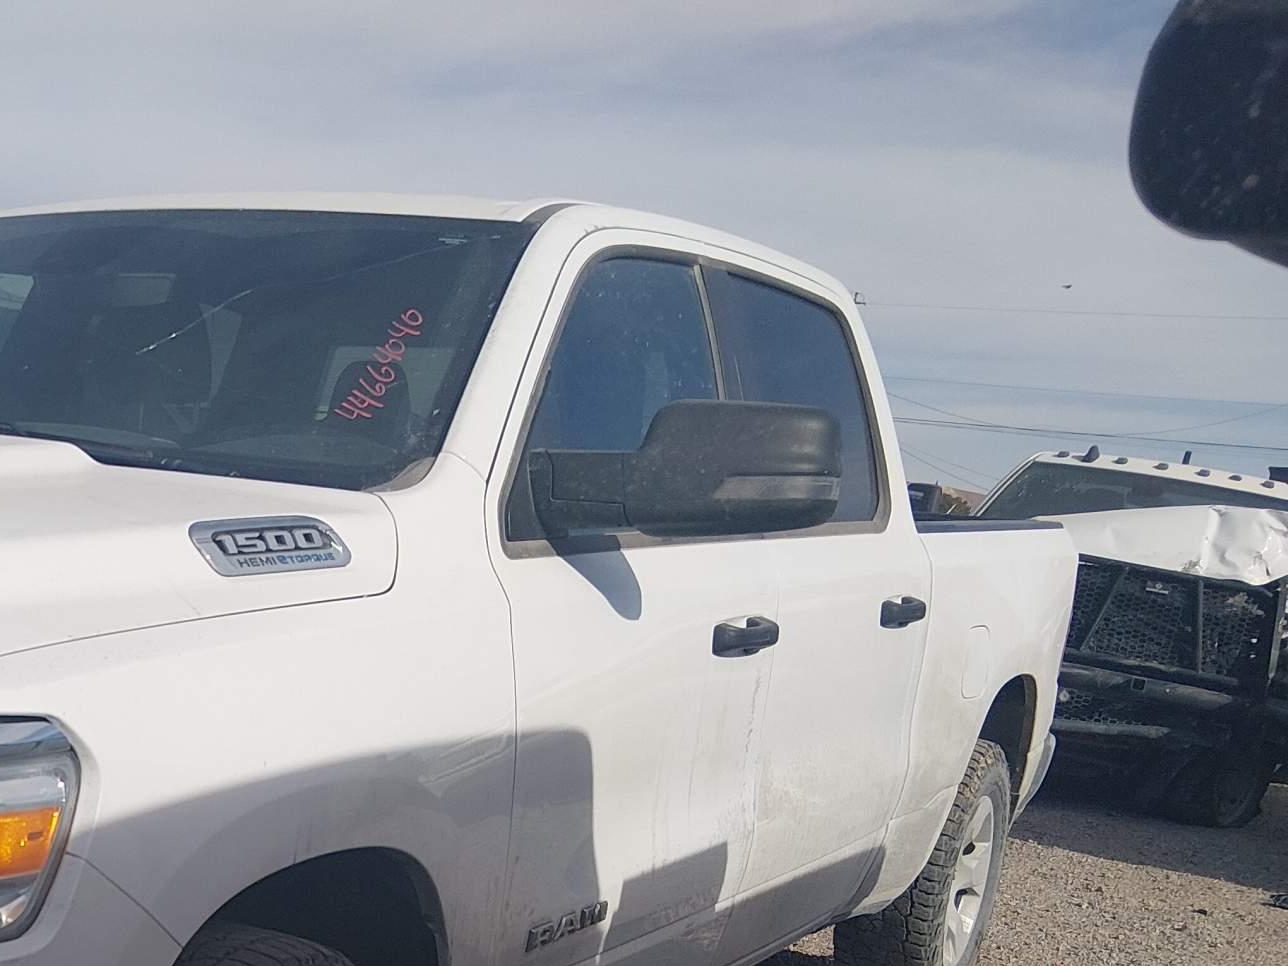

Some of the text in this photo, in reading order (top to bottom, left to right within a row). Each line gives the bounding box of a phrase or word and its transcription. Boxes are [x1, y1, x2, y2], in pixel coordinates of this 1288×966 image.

[334, 308, 423, 420] 44664040
[214, 527, 324, 555] 1500
[237, 555, 277, 568] HEMI
[524, 900, 609, 953] RAM
